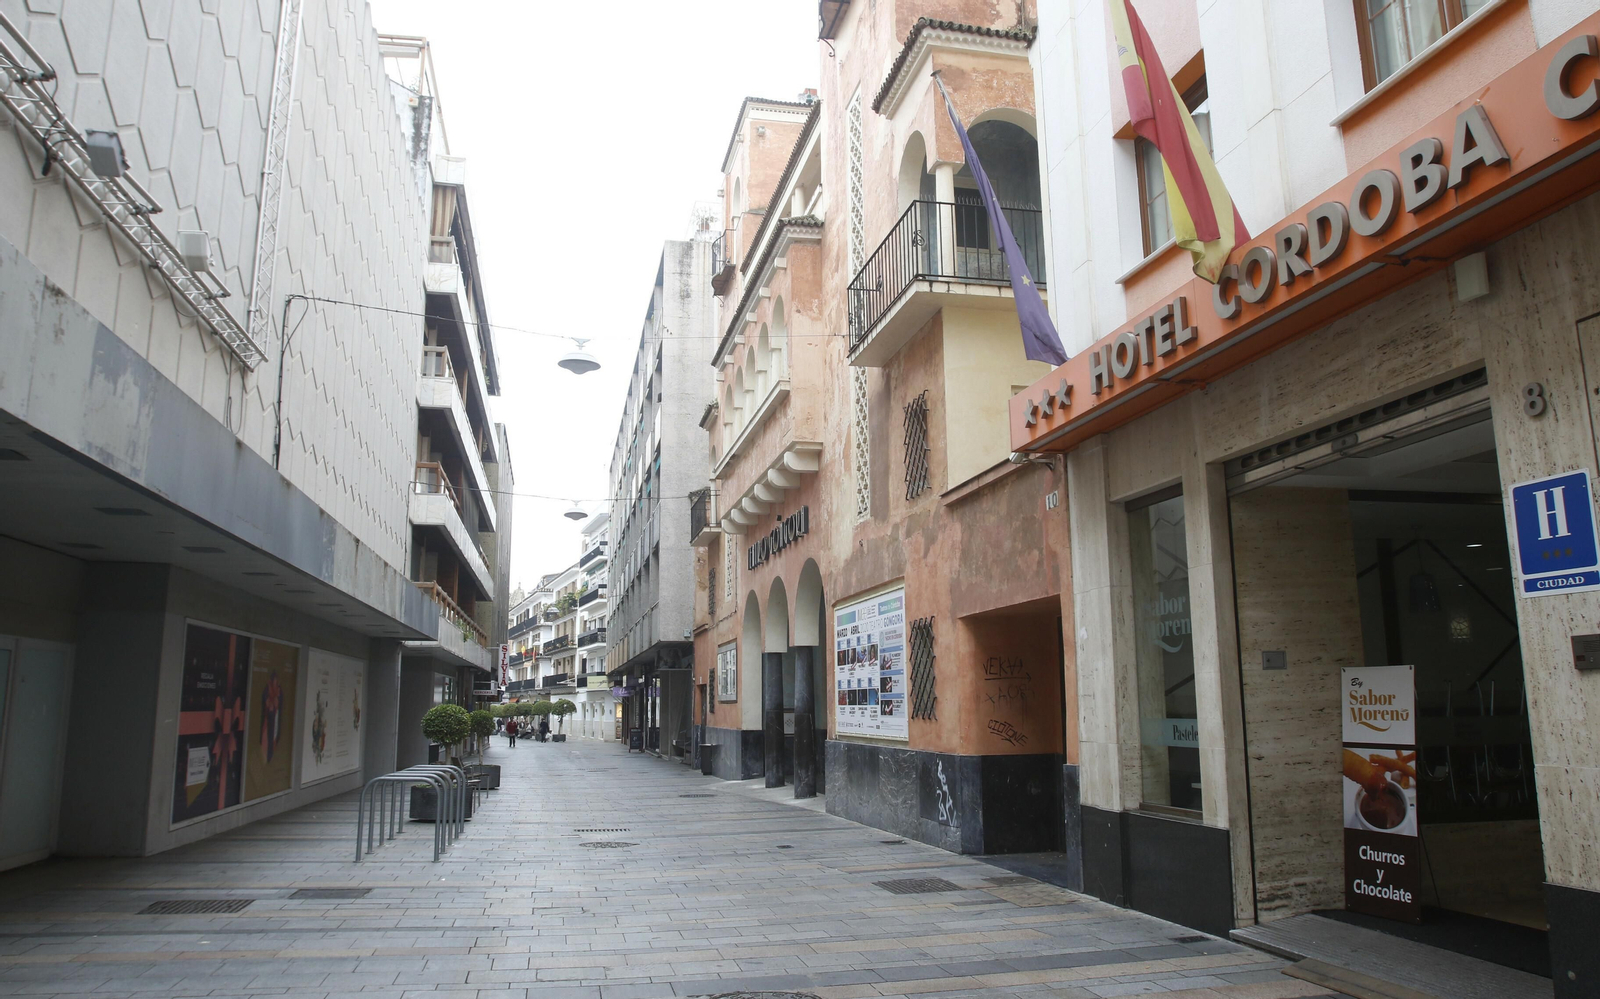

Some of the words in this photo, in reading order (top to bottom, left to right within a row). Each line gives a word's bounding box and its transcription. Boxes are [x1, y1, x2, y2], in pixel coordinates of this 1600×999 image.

[1089, 296, 1198, 395] HOTEL
[1212, 104, 1509, 319] CORDOBA
[1521, 382, 1546, 417] 8
[1046, 492, 1057, 509] 10
[1533, 485, 1571, 540] H
[1536, 576, 1585, 589] CIUDAD
[850, 625, 860, 636] ABRIL
[1350, 677, 1363, 688] By
[1349, 689, 1396, 706] Sabor
[1349, 708, 1409, 728] Moreno
[1359, 845, 1405, 866] Churros
[1376, 868, 1384, 883] y
[1353, 879, 1412, 903] Chocolate
